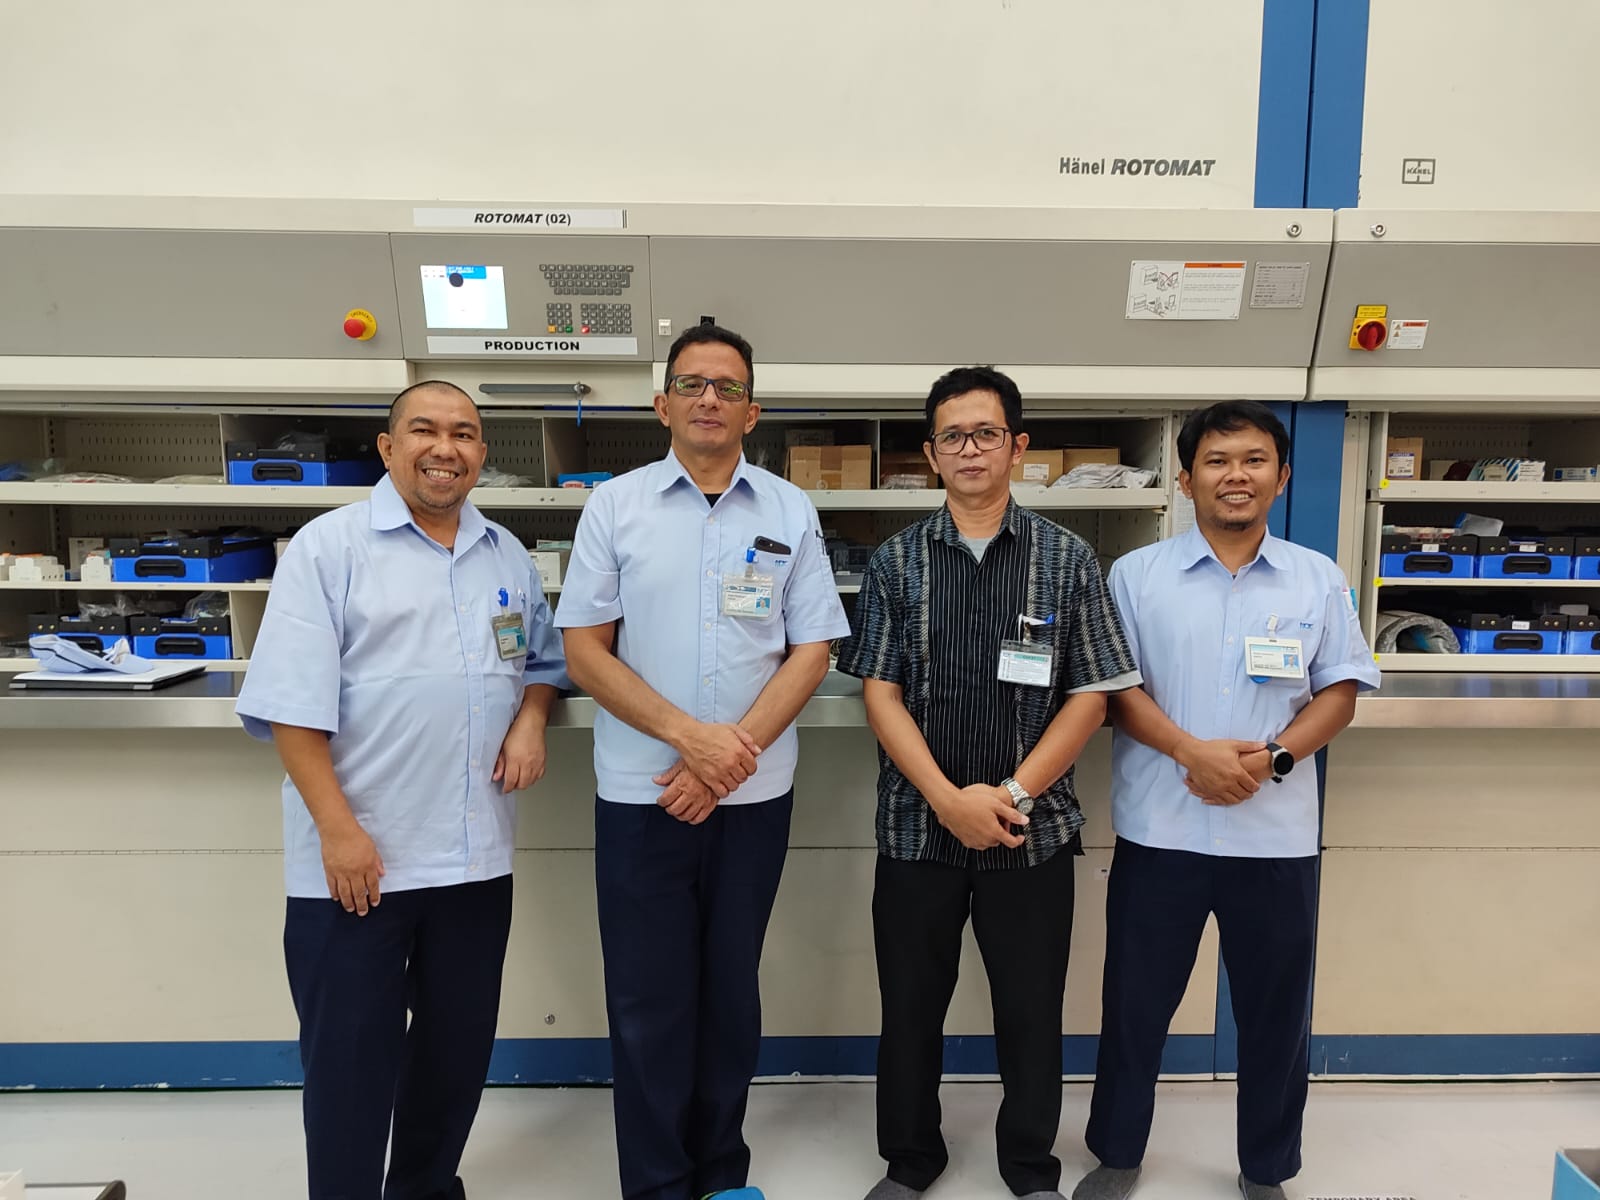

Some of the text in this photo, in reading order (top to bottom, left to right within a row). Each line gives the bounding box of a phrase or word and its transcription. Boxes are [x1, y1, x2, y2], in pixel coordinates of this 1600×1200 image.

[1059, 157, 1217, 176] Hänel ROTOMAT
[474, 213, 571, 226] ROTOMAT (02)
[484, 341, 580, 351] PRODUCTION
